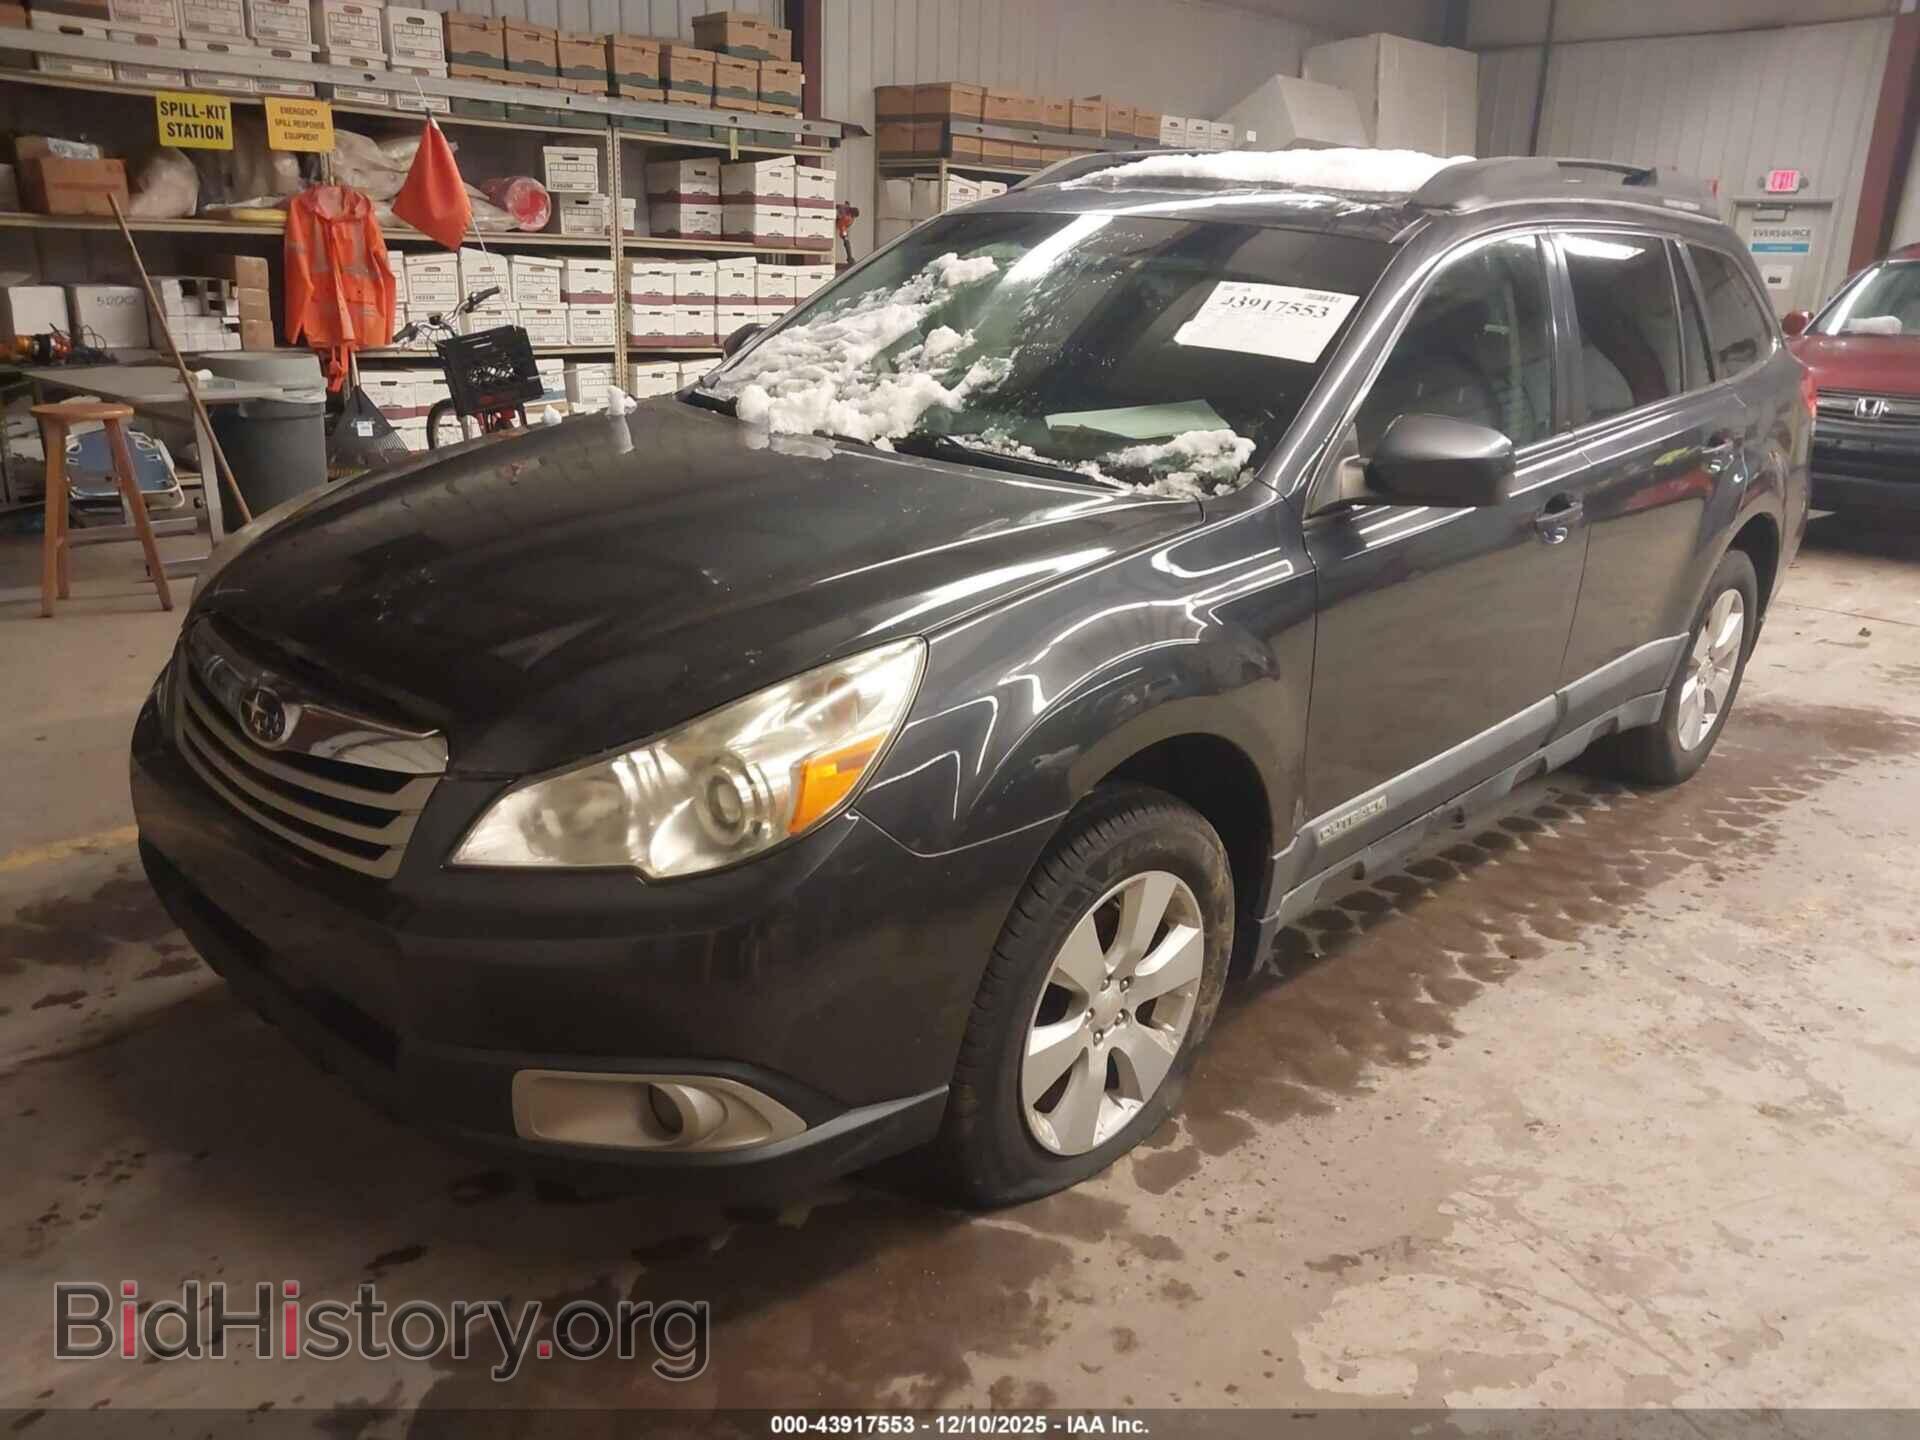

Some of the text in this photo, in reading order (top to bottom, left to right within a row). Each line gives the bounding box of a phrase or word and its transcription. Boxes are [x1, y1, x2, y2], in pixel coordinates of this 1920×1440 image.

[160, 101, 226, 120] SPILL-KIT
[280, 106, 318, 116] EMERGENCY
[167, 122, 224, 140] STATION
[1753, 229, 1810, 237] EVERSOURCE
